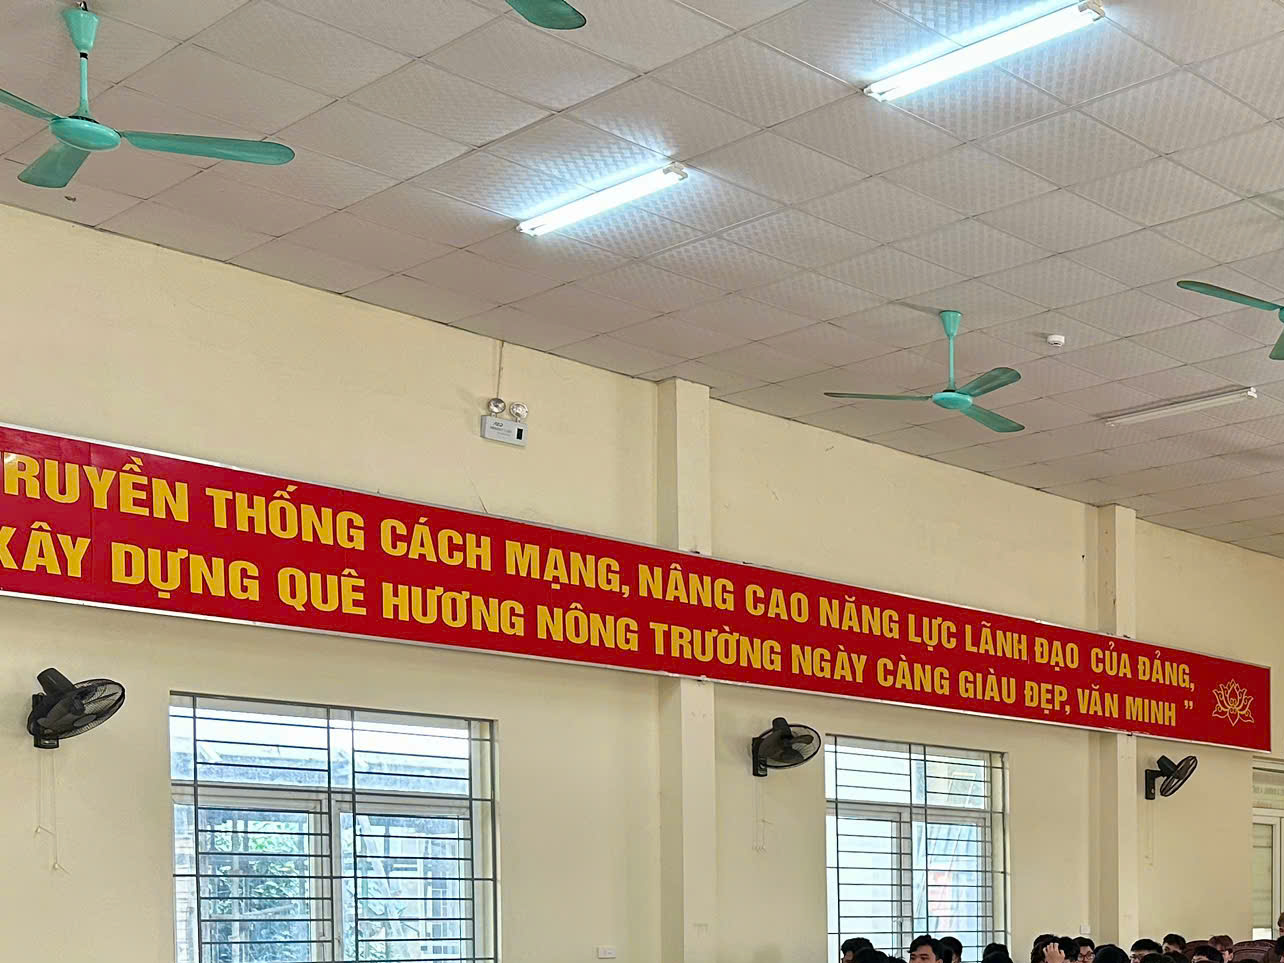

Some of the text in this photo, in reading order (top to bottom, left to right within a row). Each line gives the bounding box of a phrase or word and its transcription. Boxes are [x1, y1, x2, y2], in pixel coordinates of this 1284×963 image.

[0, 453, 1195, 692] RUYỀN THỐNG CÁCH MẠNG, NÂNG CAO NĂNG LỰC LÃNH ĐẠO CỦA ĐẢNG,
[111, 543, 260, 601] DỰNG
[277, 567, 367, 615] QUÊ
[383, 582, 525, 637] HƯƠNG
[536, 602, 639, 651] NÔNG
[649, 623, 782, 671] TRƯỜNG
[791, 644, 867, 683] NGÀY
[876, 655, 950, 695] CÀNG
[958, 667, 1016, 704] GIÀU
[1024, 680, 1071, 715] ĐẸP,
[1077, 685, 1119, 718] VĂN
[1125, 695, 1176, 727] MINH
